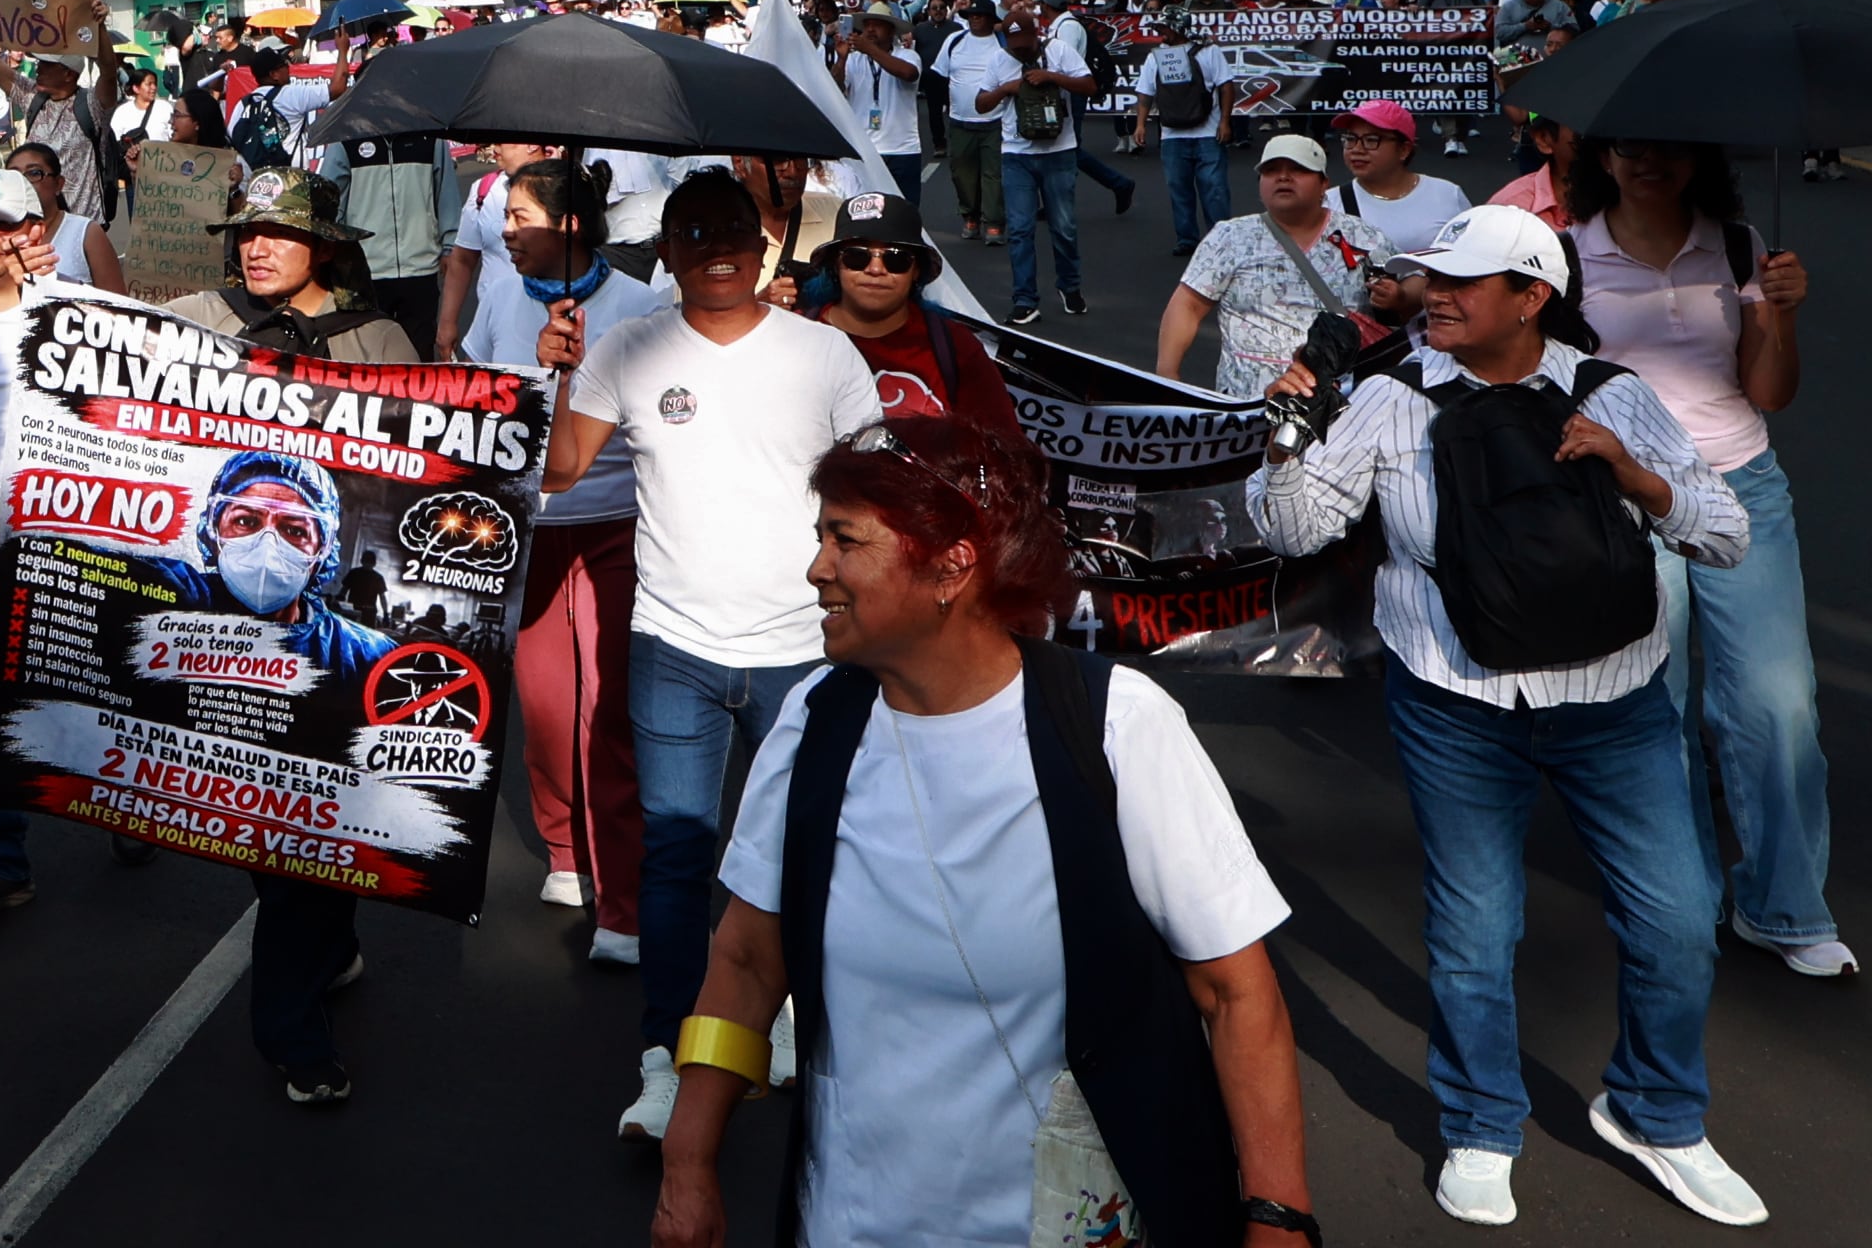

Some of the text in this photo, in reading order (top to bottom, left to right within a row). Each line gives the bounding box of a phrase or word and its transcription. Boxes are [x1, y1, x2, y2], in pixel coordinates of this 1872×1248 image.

[1138, 22, 1487, 37] TBAJANDO BAJO PROTESTA
[1139, 8, 1487, 27] ABULANCIAS MODULO 3
[1218, 32, 1403, 42] CON APOYO SINDICAL
[1336, 45, 1488, 56] SALARIO DIGNO
[1164, 73, 1186, 81] IMSS
[1381, 62, 1488, 73] FUERA LAS
[1411, 73, 1488, 83] AFORES
[1342, 89, 1488, 100] COBERTURA DE
[53, 307, 148, 356] CON
[157, 320, 240, 370] MIS
[34, 341, 531, 472] SALVAMOS AL PAÍS
[1009, 392, 1065, 427] OS
[21, 415, 185, 463] Con 2 neuronas todos los días
[116, 404, 426, 480] EN LA PANDEMIA COVID
[21, 475, 175, 534] HOY NO
[1071, 492, 1135, 510] CORRUPCIÓN!
[402, 559, 505, 595] 2 NEURONAS
[158, 615, 263, 638] Gracias a dios
[1111, 578, 1271, 648] PRESENTE
[148, 641, 299, 681] 2 neuronas
[173, 636, 254, 656] solo tengo
[98, 712, 361, 788] DÍA A DÍA LA SALUD DEL PAÍS
[378, 730, 462, 746] SINDICATO
[98, 748, 126, 779] 2
[114, 733, 338, 800] ESTÁ EN MANOS DE ESAS
[366, 743, 476, 776] CHARRO
[89, 784, 356, 867] PIÉNSALO 2 VECES
[67, 799, 380, 890] ANTES DE VOLVERNOS A INSULTAR
